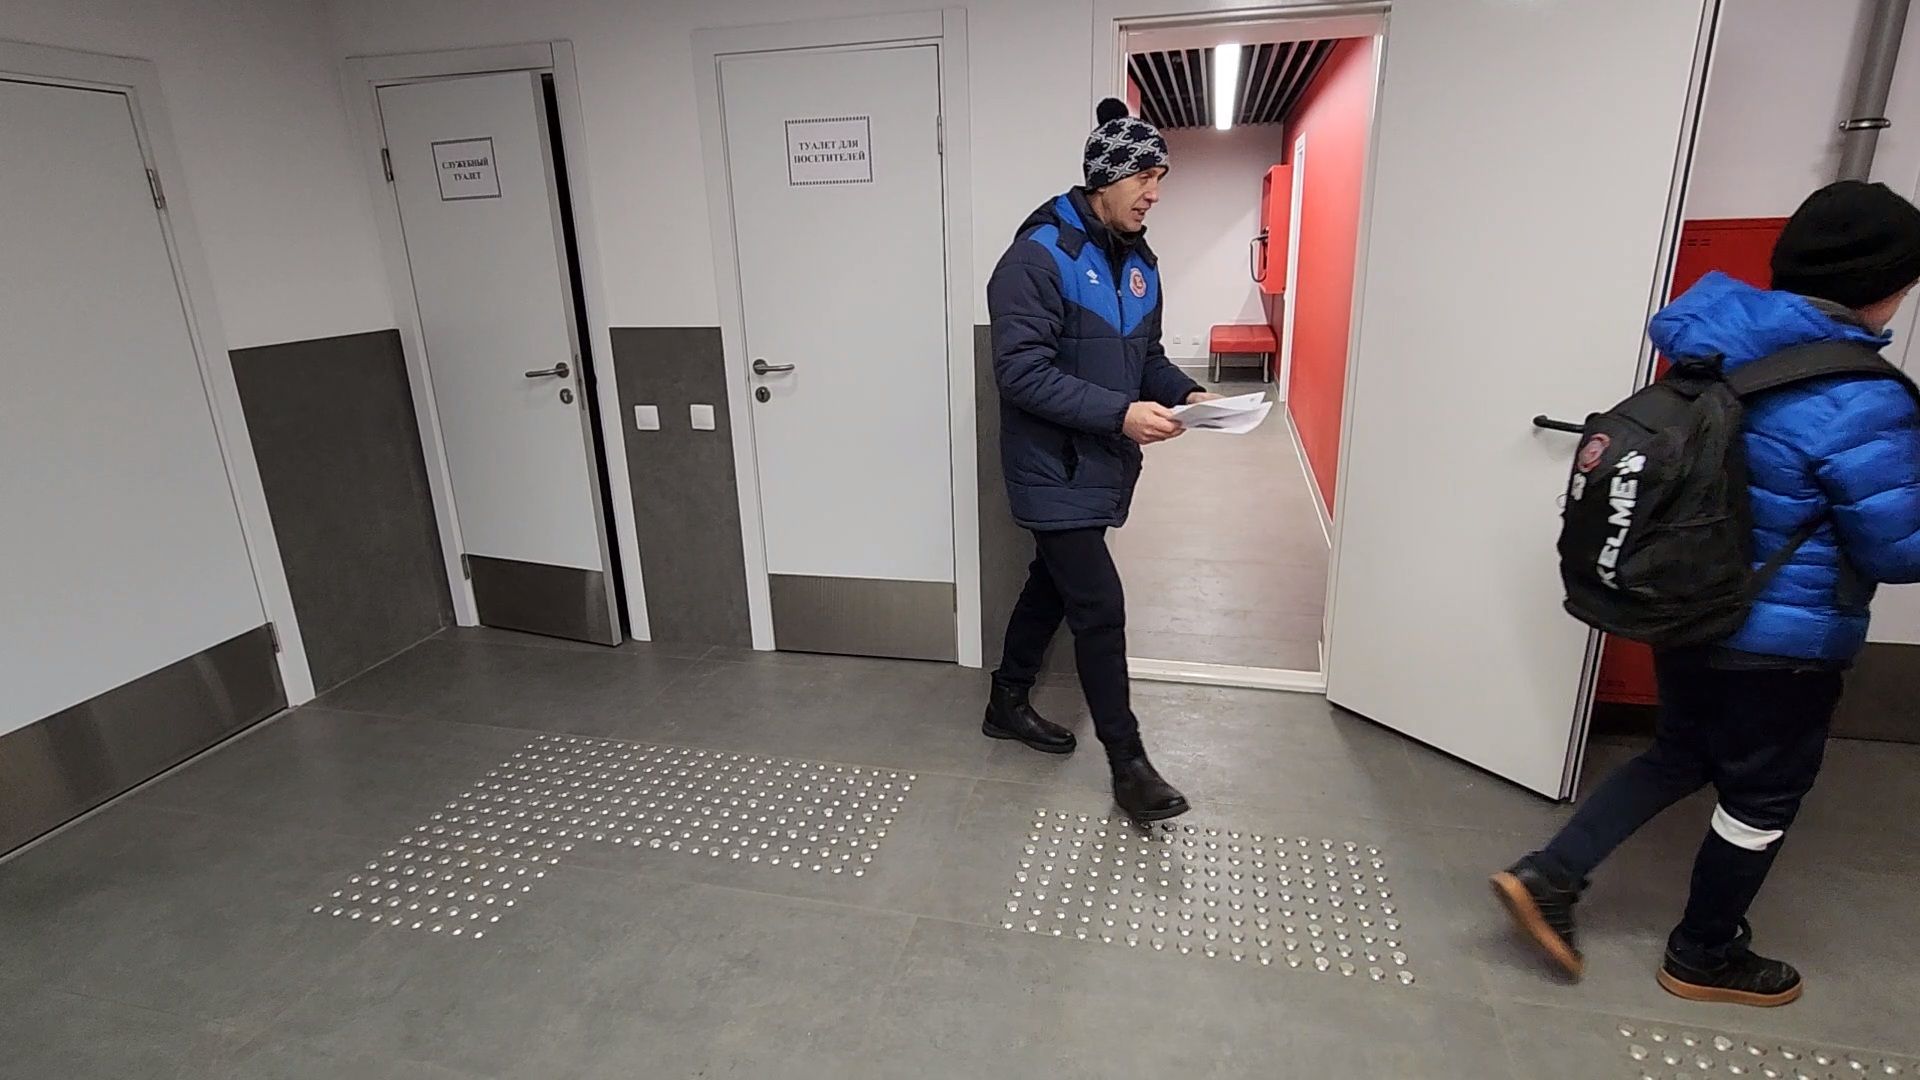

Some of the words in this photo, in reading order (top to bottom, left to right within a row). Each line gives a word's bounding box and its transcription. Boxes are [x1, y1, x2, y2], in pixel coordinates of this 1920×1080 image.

[798, 140, 836, 151] ТУАЛЕТ
[838, 139, 858, 150] ДЛЯ
[442, 157, 489, 169] СЛУЖЕБНЫЙ
[794, 151, 865, 164] ПОСЕТИТЕЛЕЙ
[453, 172, 481, 182] ТУАЛЕТ
[1596, 476, 1638, 590] KELME
